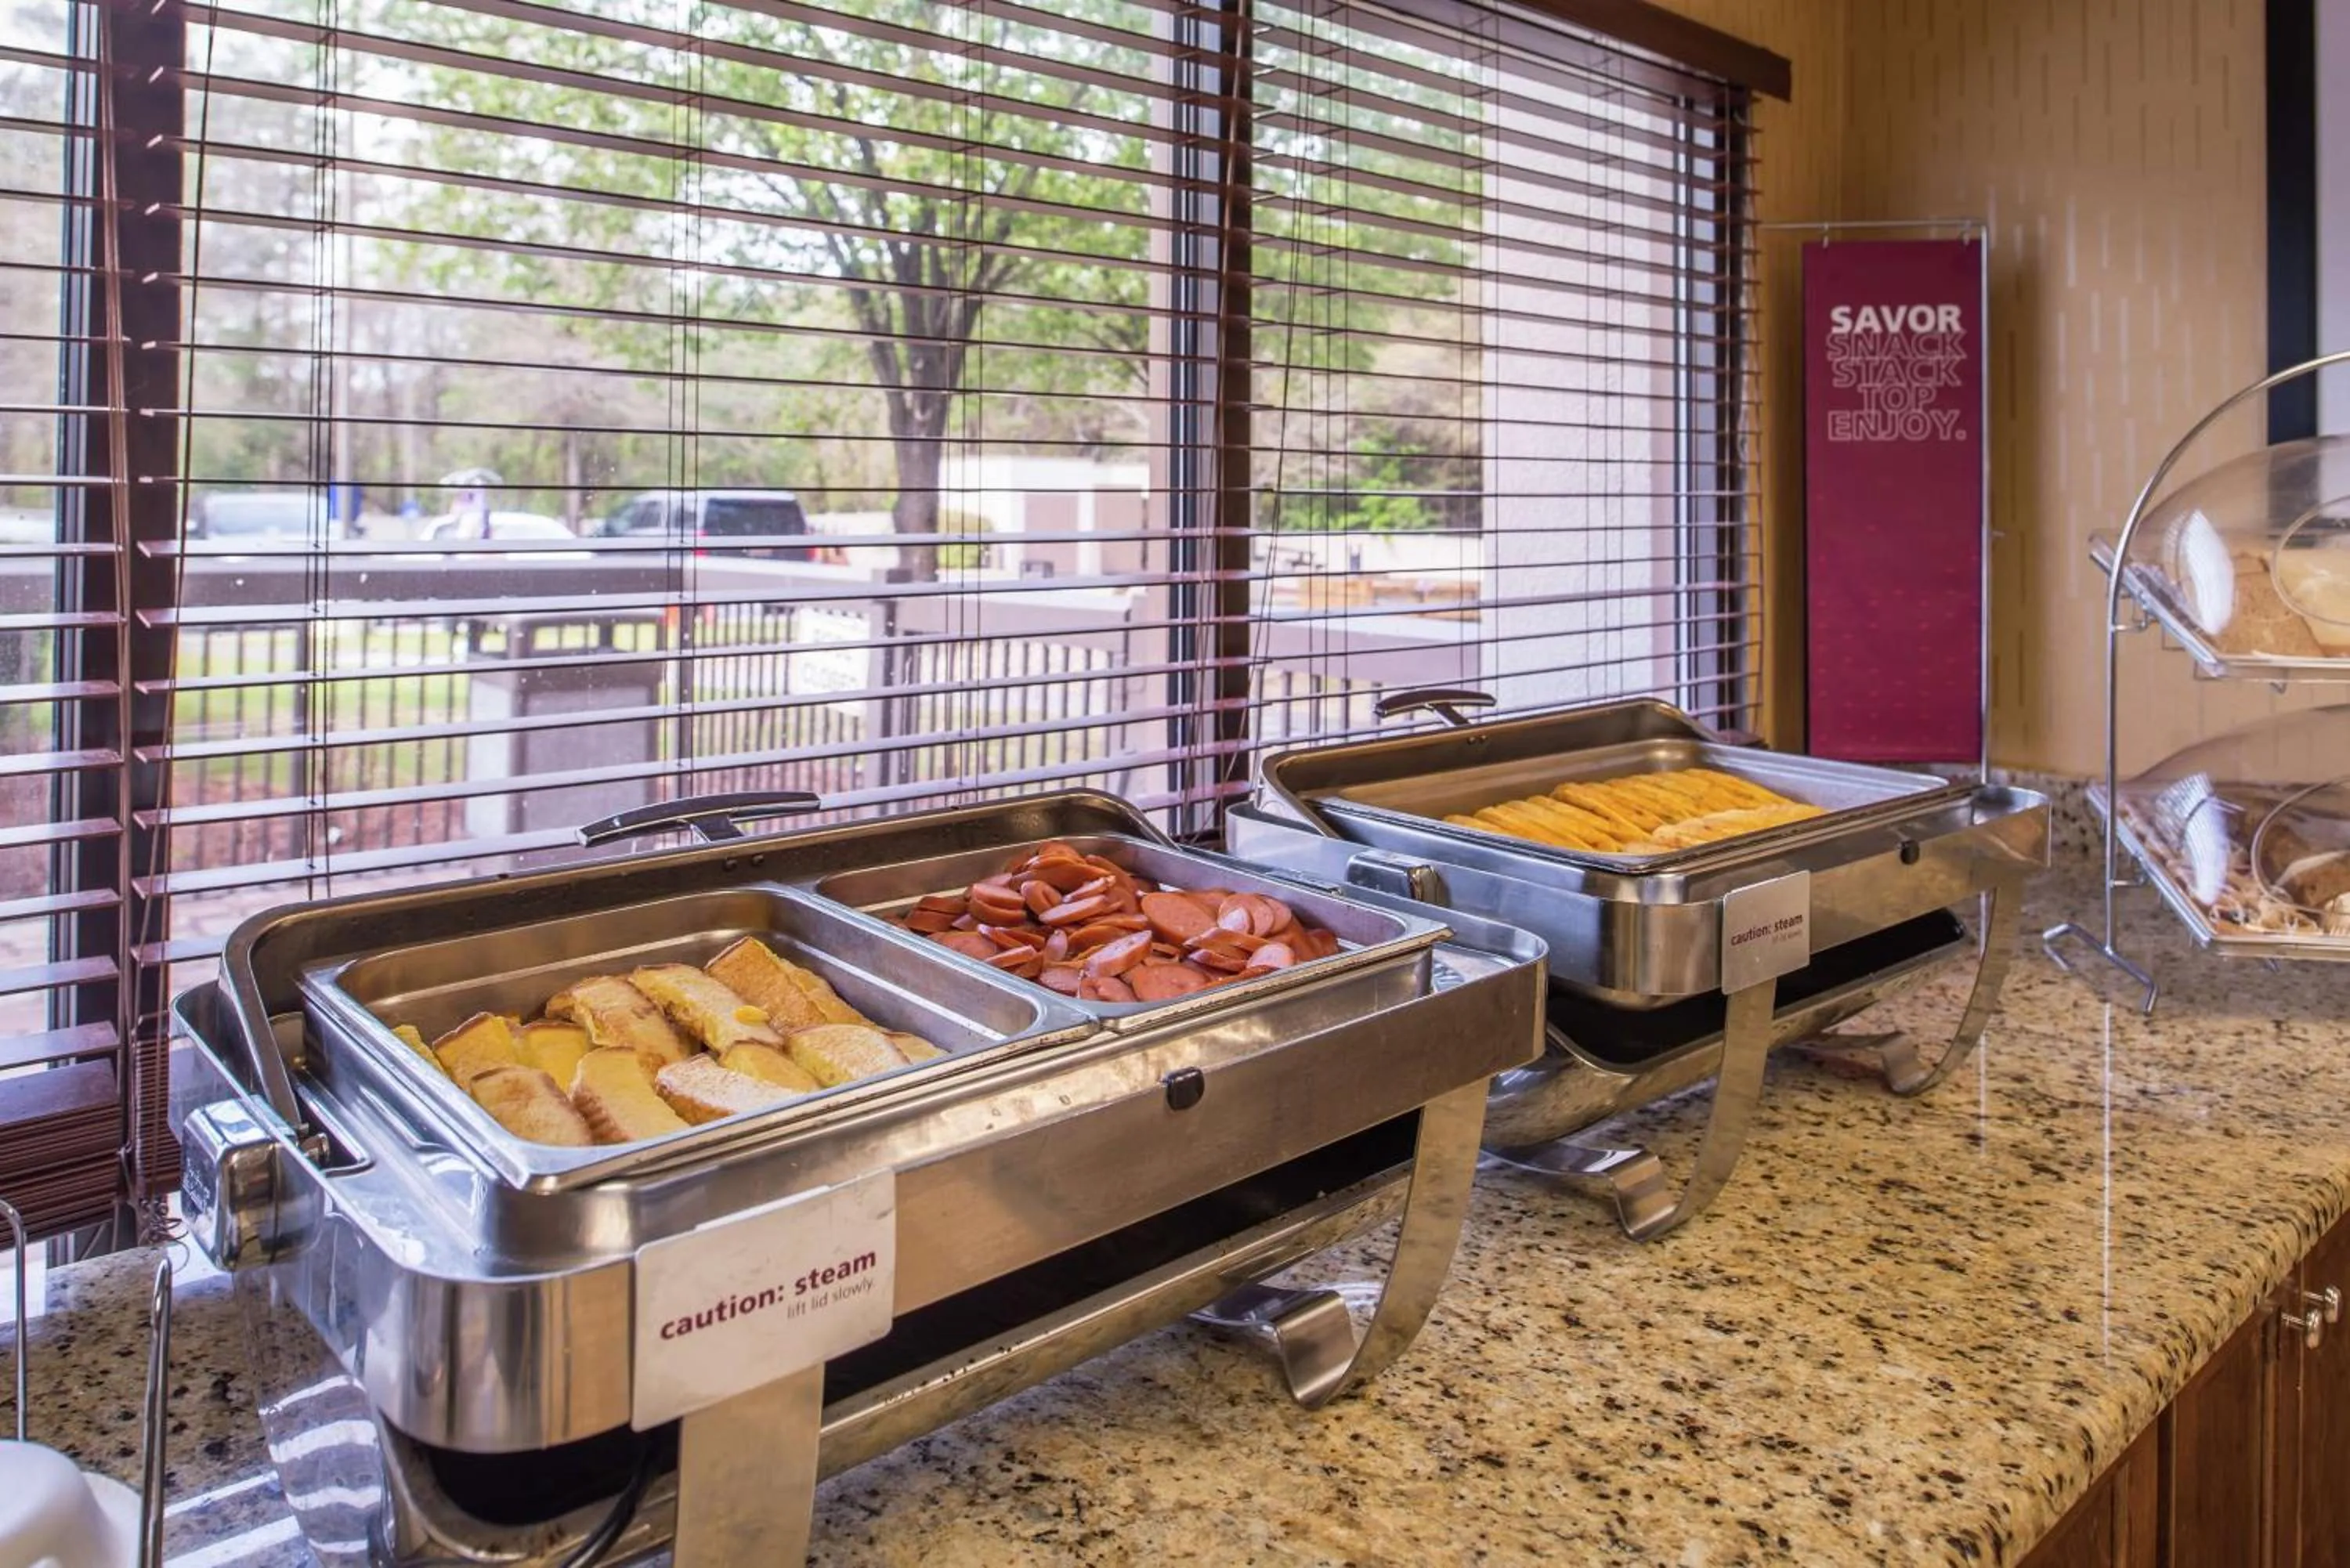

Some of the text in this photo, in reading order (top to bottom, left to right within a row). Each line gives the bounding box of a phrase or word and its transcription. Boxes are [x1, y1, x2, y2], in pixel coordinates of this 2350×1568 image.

[1830, 304, 1962, 334] SAVOR
[1826, 329, 1967, 361] SNACK
[1831, 356, 1962, 388] STACK
[1857, 384, 1936, 413] TOP
[1828, 410, 1967, 441] ENJOY.
[1730, 924, 1771, 946] caution:
[1773, 914, 1803, 932] steam
[660, 1251, 877, 1341] caution: steam
[787, 1301, 806, 1319] lift
[811, 1292, 828, 1311] lid
